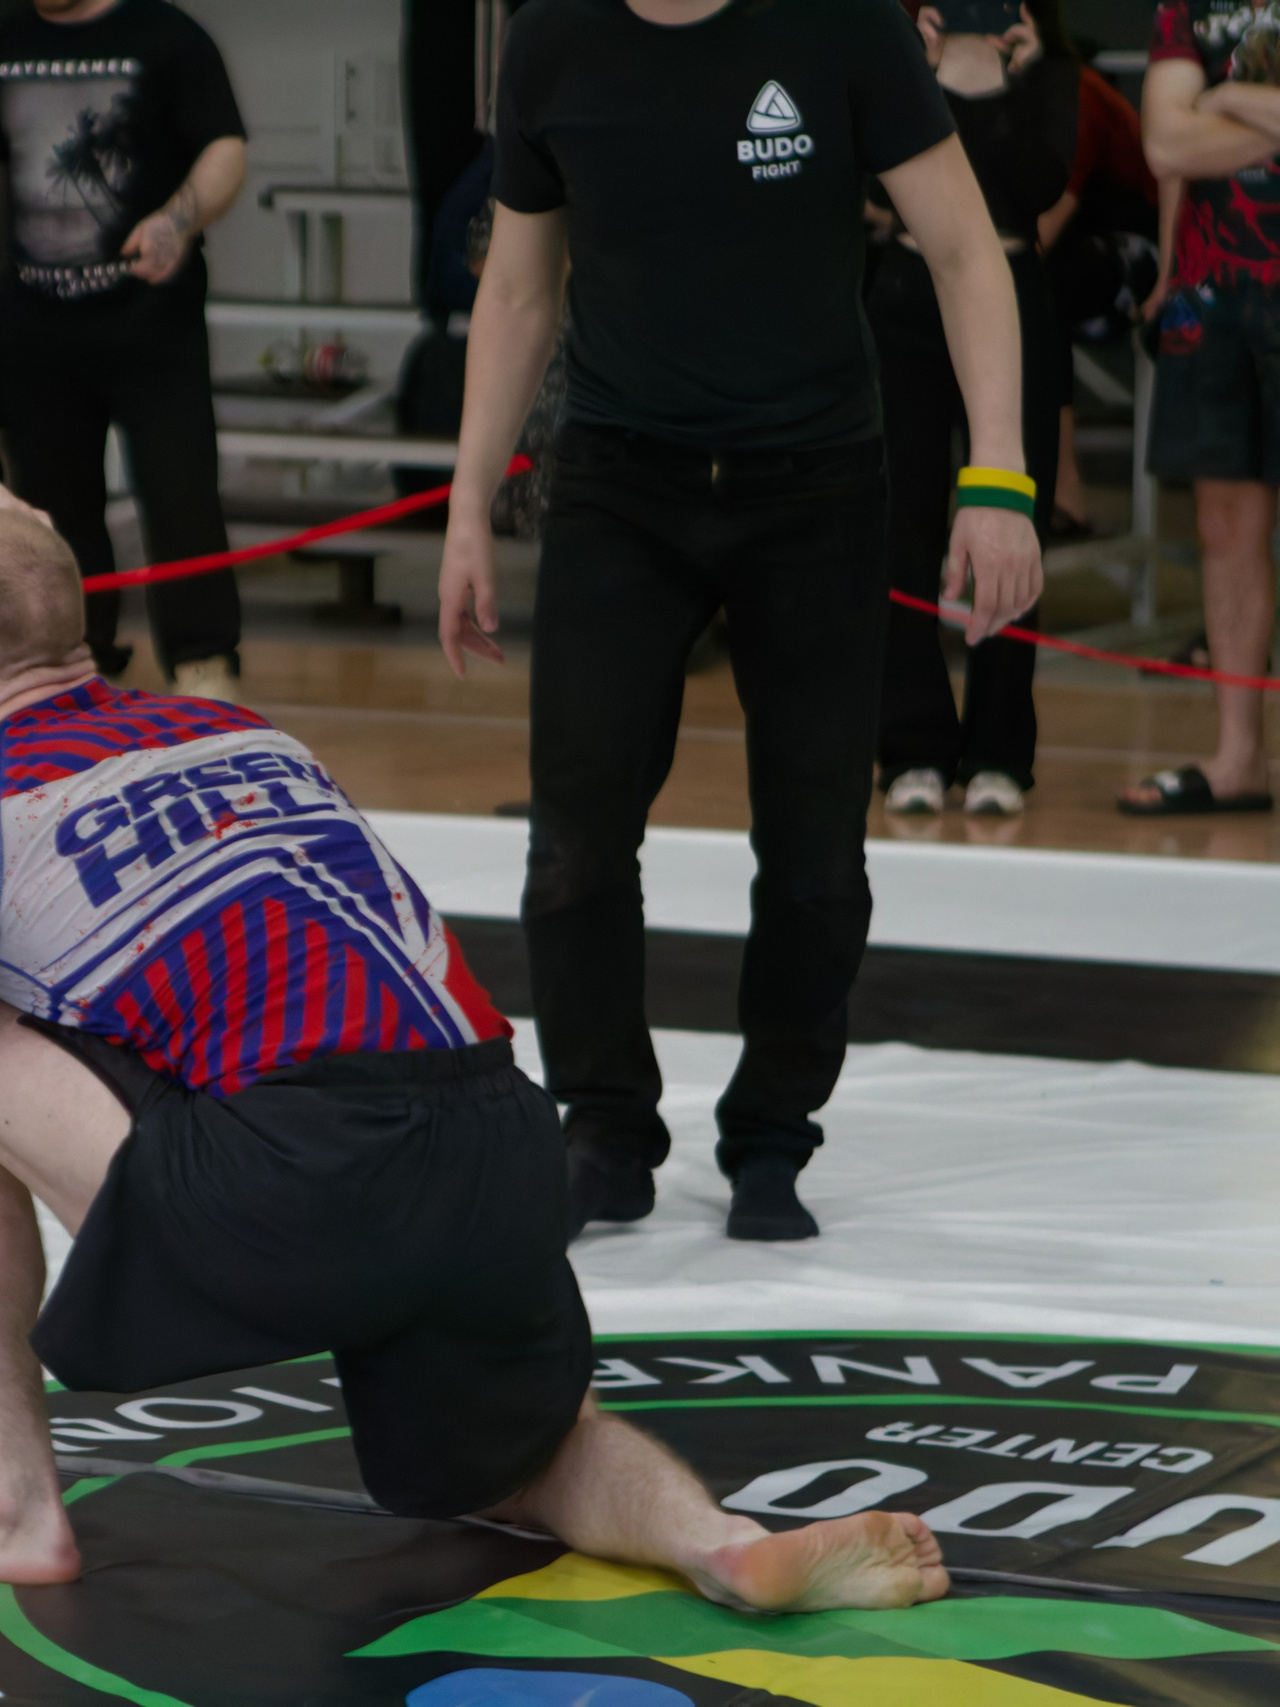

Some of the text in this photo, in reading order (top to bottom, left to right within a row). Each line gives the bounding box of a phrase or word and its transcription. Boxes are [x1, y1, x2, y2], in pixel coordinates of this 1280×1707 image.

[737, 134, 813, 162] BUDO
[752, 161, 800, 180] FIGHT
[55, 752, 336, 857] GREEN
[75, 781, 337, 908] HILL
[866, 1421, 1214, 1473] CENTER
